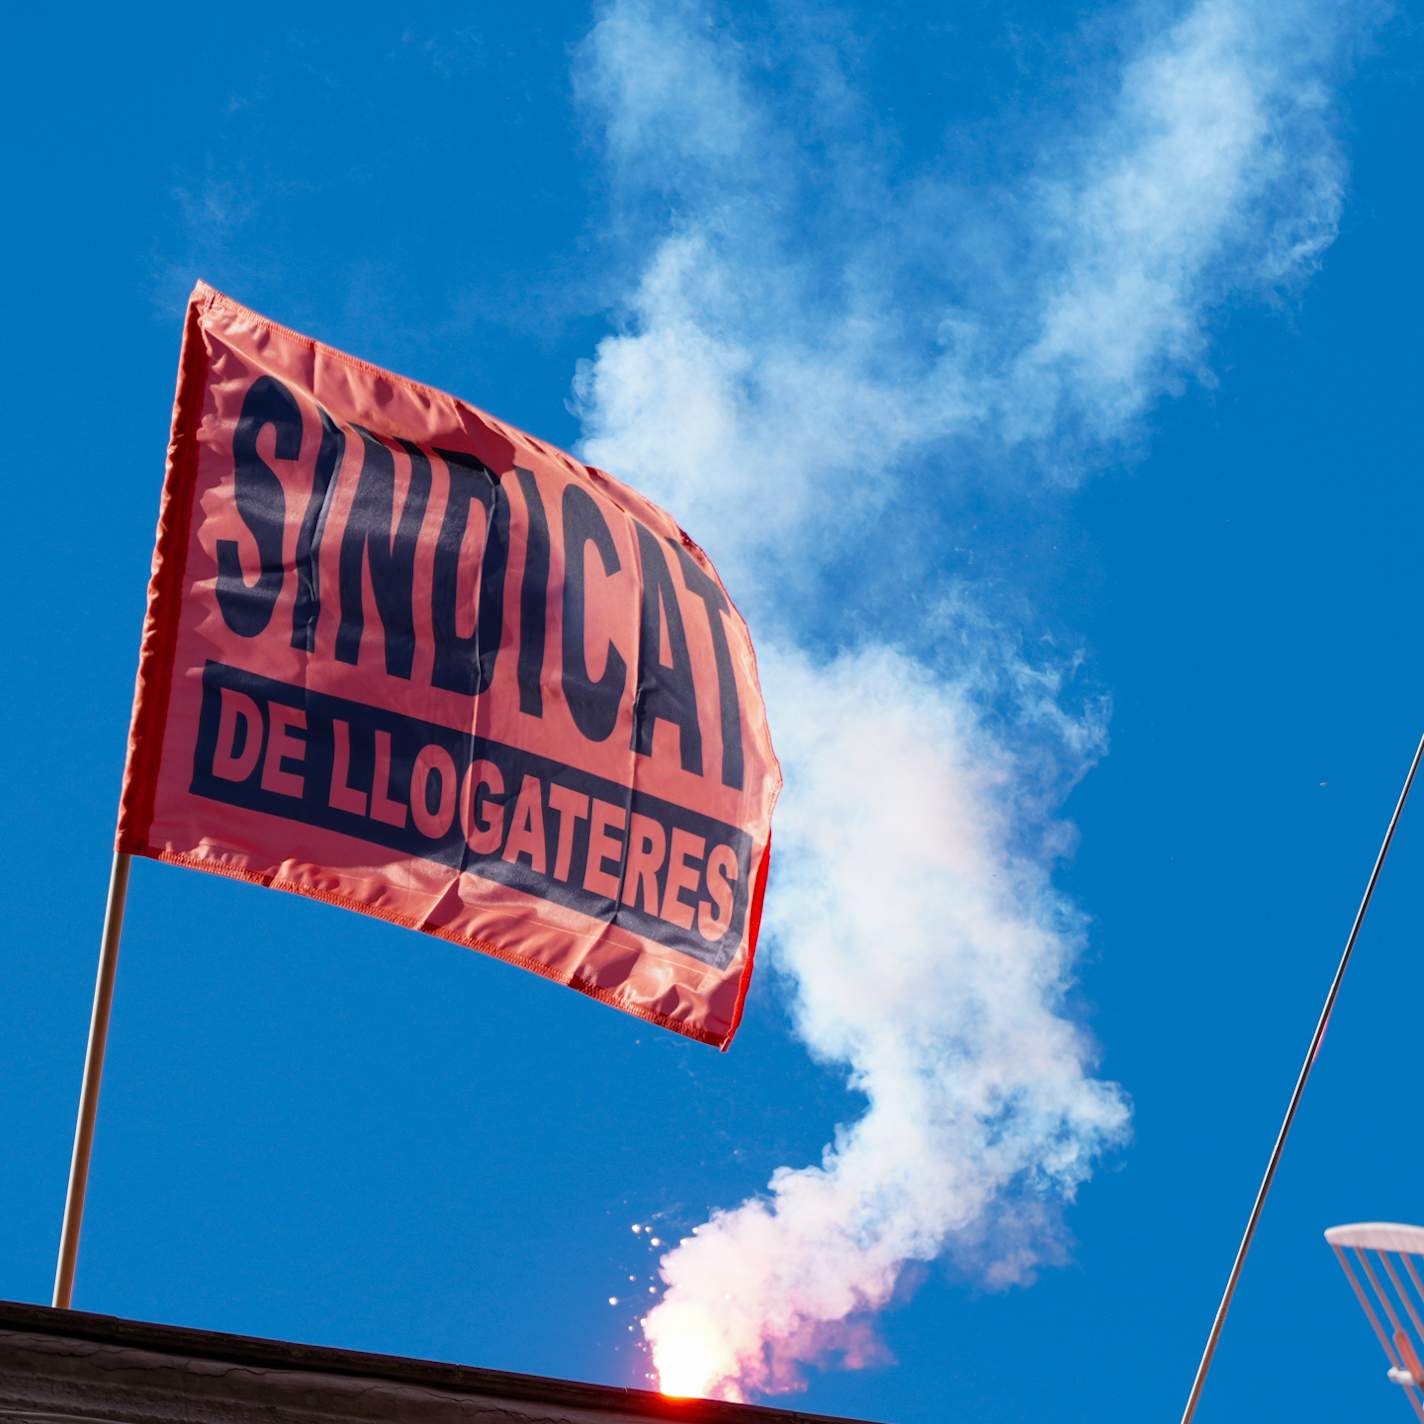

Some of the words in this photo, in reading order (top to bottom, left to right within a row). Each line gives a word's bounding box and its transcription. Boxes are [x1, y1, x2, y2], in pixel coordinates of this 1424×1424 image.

[215, 374, 745, 791] SINDICAT
[212, 687, 309, 799] DE
[328, 718, 740, 943] LLOGATERES
